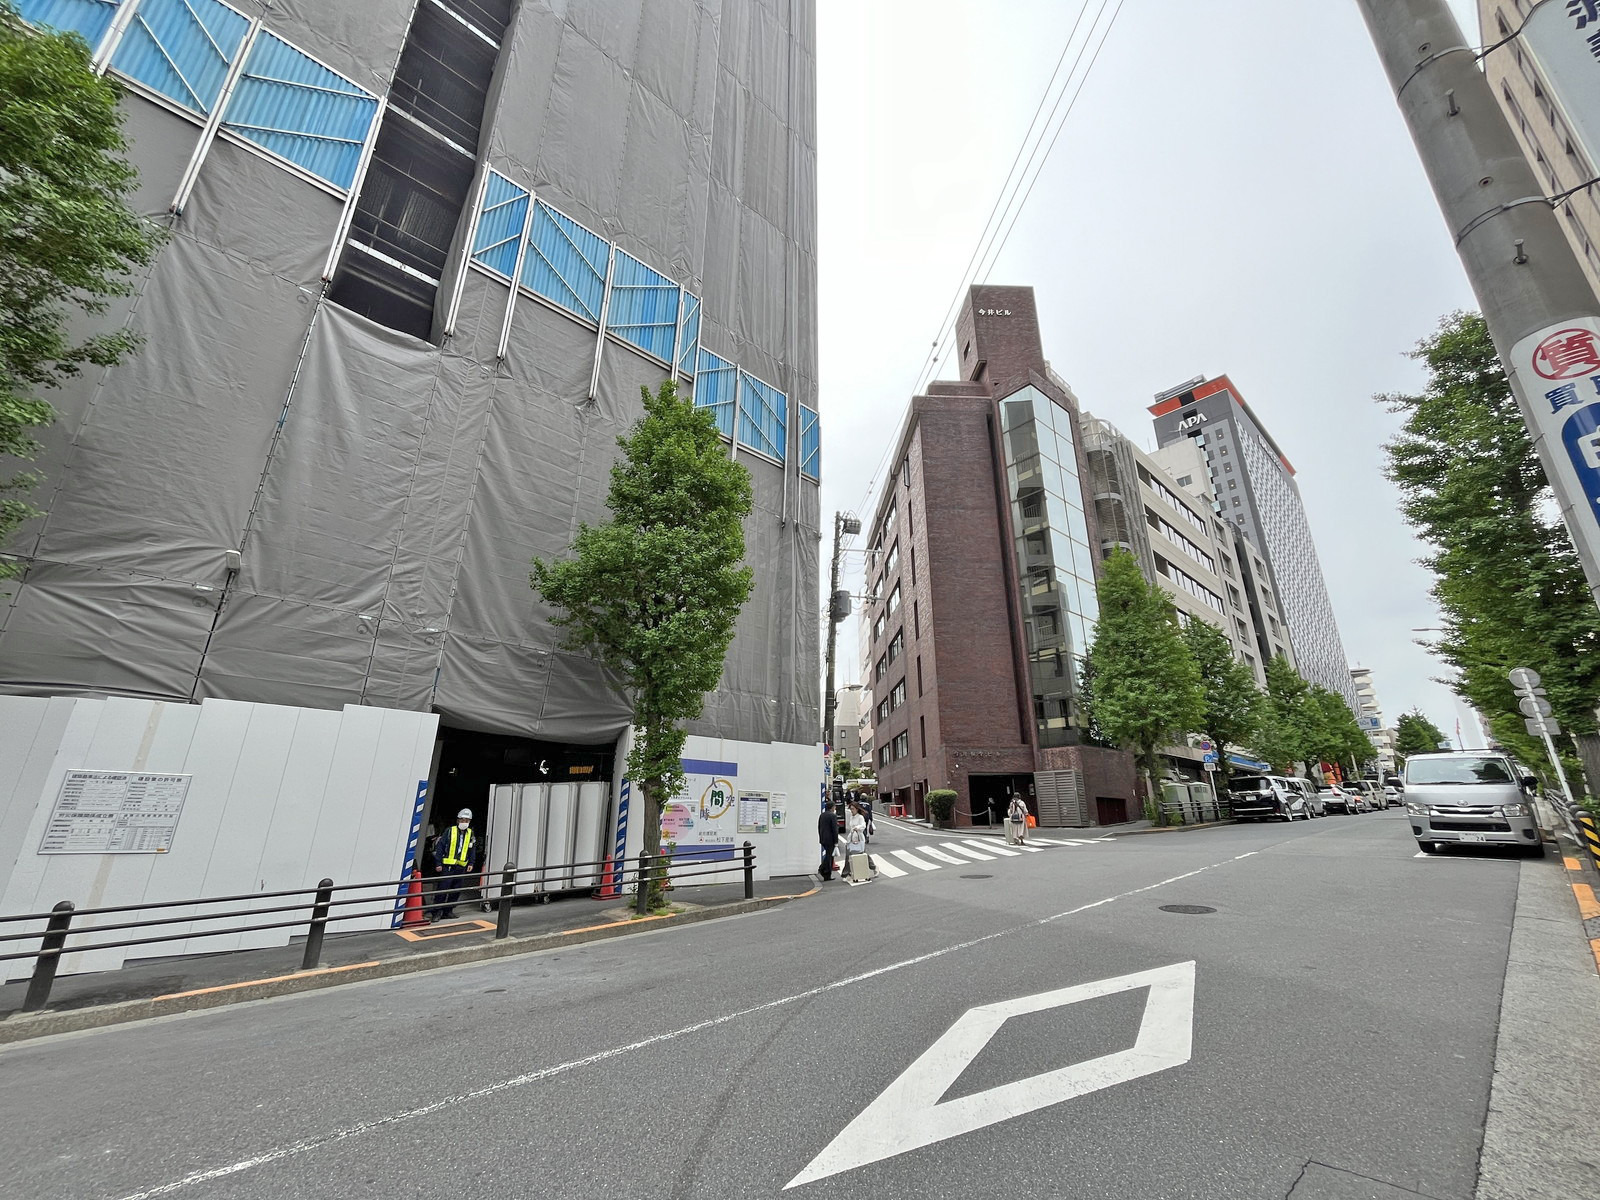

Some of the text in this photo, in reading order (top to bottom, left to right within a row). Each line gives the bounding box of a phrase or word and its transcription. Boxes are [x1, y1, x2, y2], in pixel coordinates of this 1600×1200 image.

[978, 308, 1012, 316] 今井ビル
[1178, 413, 1208, 431] APA
